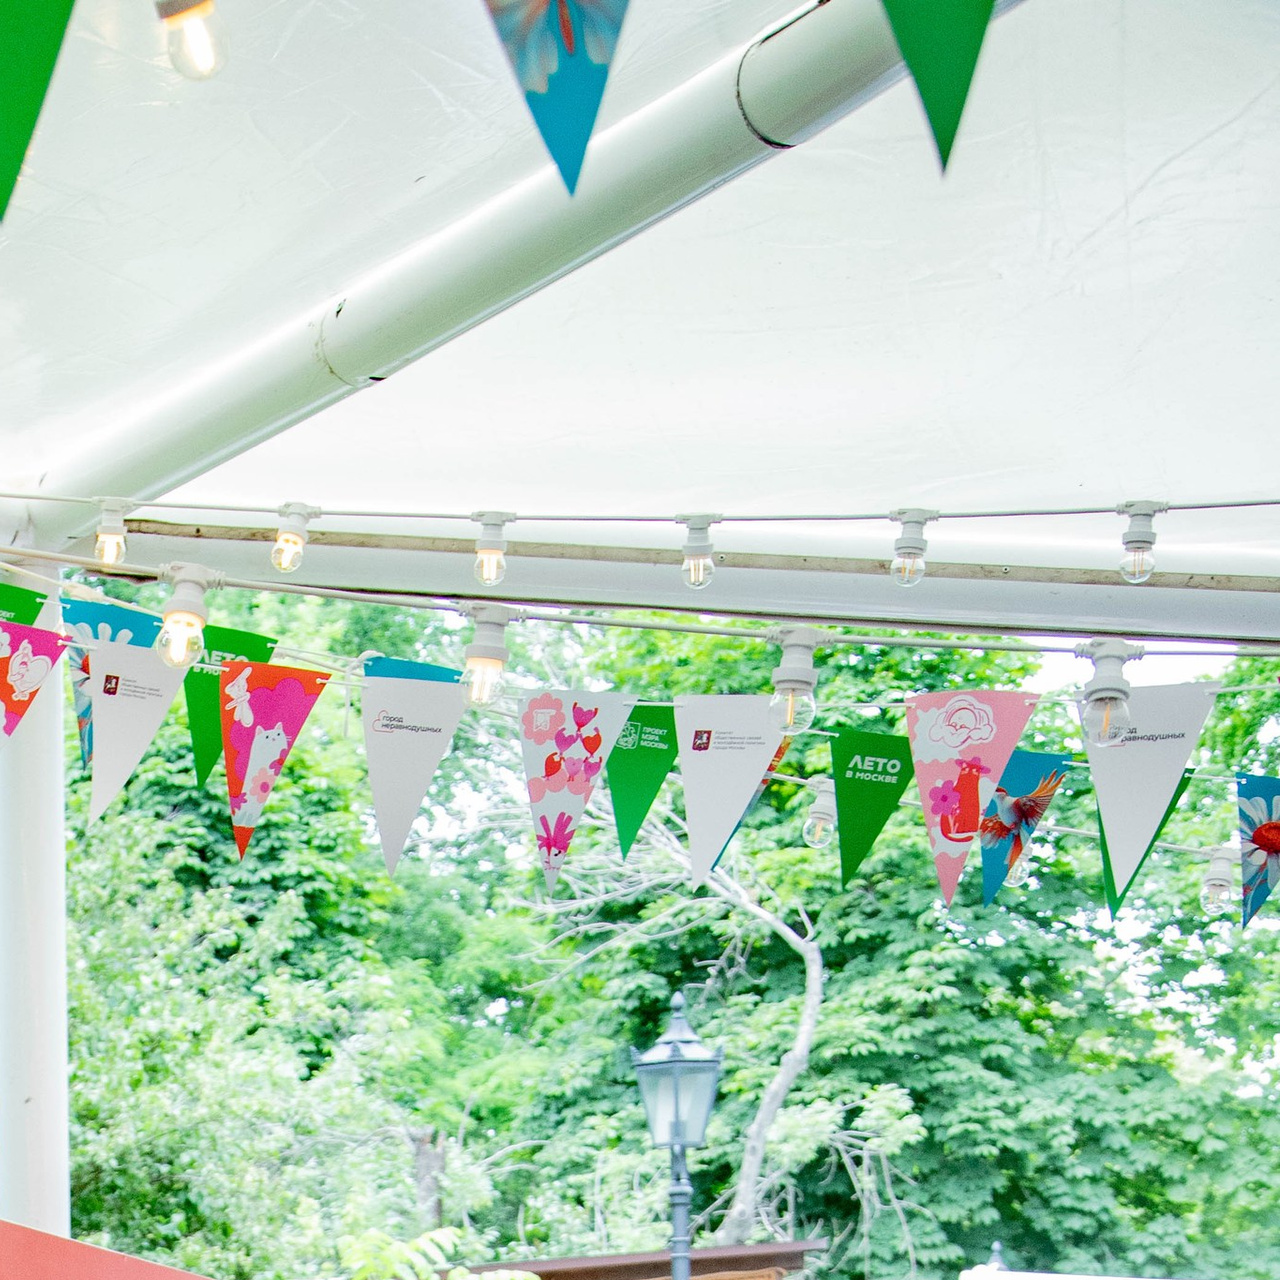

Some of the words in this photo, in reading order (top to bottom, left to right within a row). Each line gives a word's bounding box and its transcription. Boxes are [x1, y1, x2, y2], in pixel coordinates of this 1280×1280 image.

[382, 715, 404, 723] город
[381, 723, 442, 734] неравнодушных
[642, 726, 668, 736] ПРОЕКТ
[641, 733, 660, 742] МЭРА
[1120, 732, 1186, 743] равнодушных
[639, 740, 669, 750] МОСКВЫ
[848, 754, 901, 773] ЛЕТО
[845, 770, 853, 778] В
[855, 771, 898, 784] МОСКВЕ
